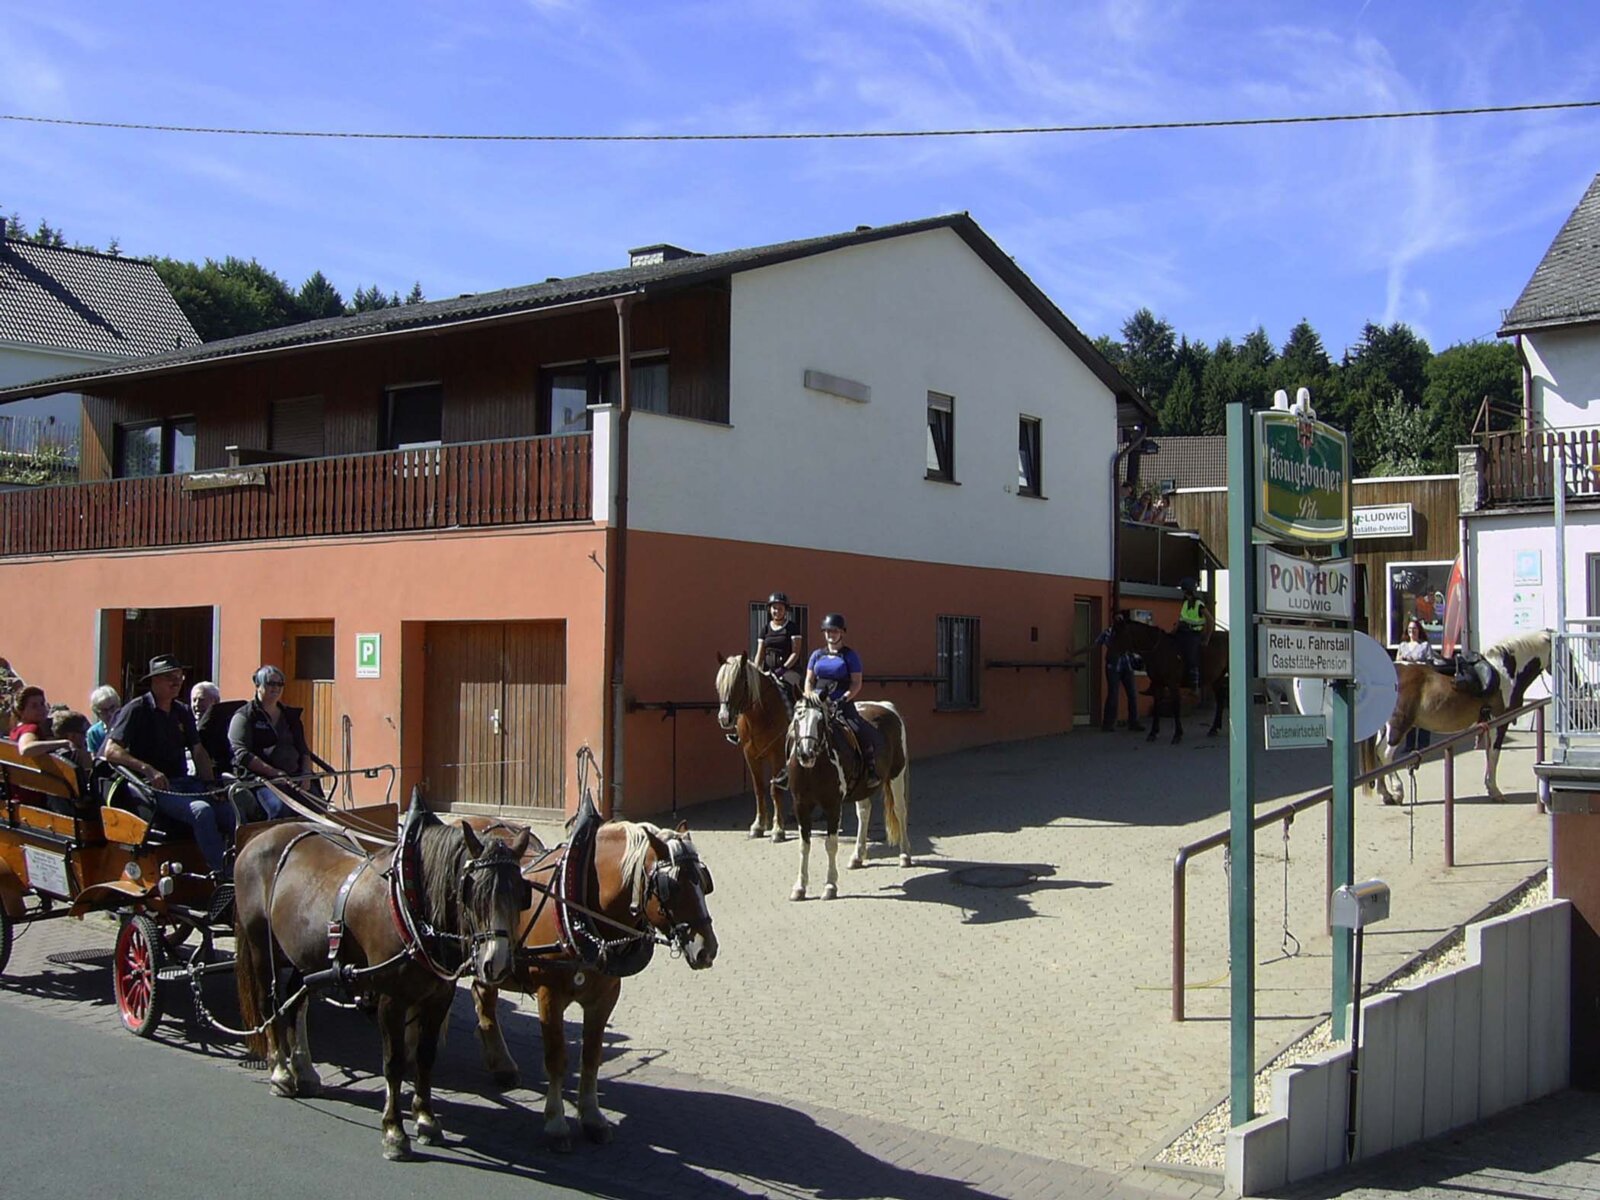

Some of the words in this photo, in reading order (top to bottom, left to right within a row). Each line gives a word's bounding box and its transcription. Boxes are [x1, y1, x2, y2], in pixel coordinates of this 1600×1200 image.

[1270, 447, 1341, 495] Königsbacher
[1365, 511, 1407, 522] LUDWIG
[1270, 564, 1348, 596] PONYHOF
[1289, 598, 1332, 611] LUDWIG
[1269, 634, 1294, 649] Reit-
[1296, 639, 1305, 649] u.
[1309, 636, 1350, 651] Fahrstall
[363, 642, 374, 662] P
[1272, 654, 1347, 670] Gaststätte-Pension
